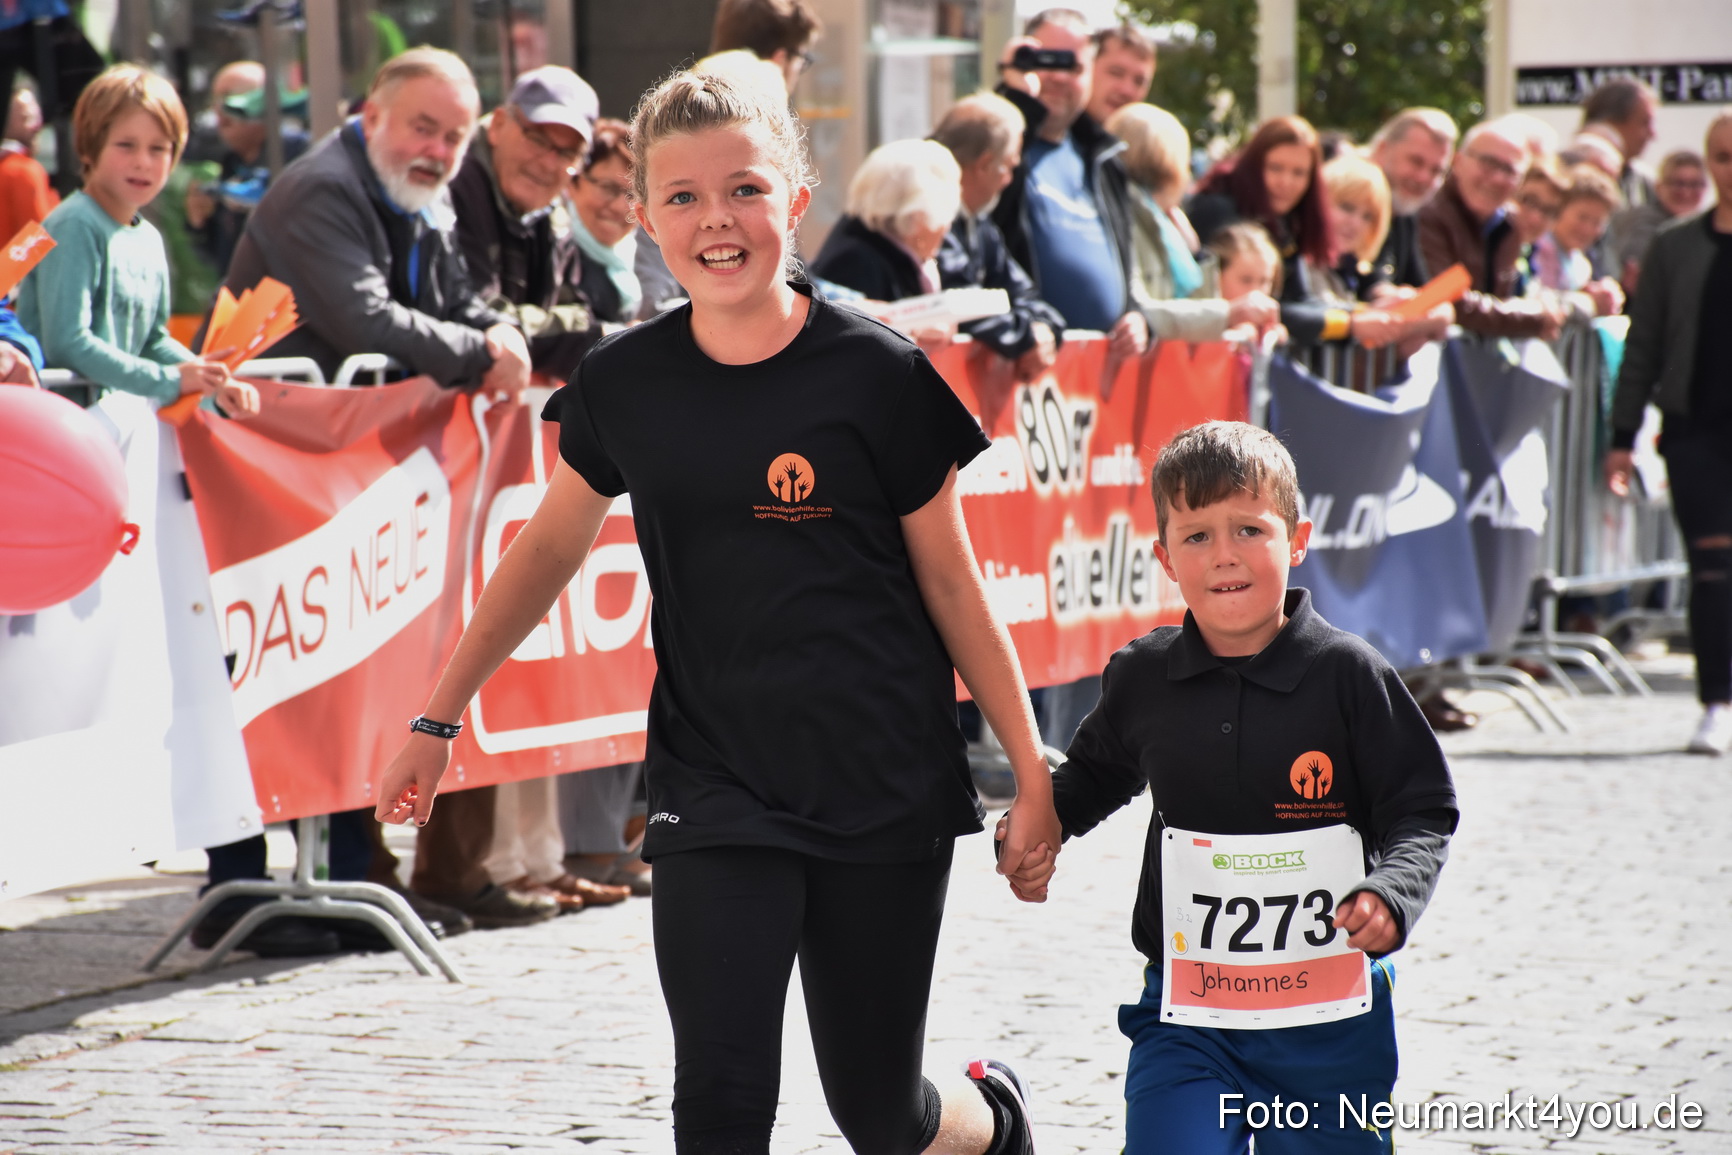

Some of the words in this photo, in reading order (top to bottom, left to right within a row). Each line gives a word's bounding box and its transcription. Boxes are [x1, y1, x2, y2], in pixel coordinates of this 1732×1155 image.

[753, 505, 832, 514] www.bolivienhilfe.com
[755, 513, 789, 521] HOFFNUNG
[790, 514, 802, 522] AUF
[225, 565, 330, 692] DAS
[349, 491, 429, 630] NEUE
[1275, 811, 1310, 820] HOFFNUNG
[1310, 811, 1323, 819] AUF
[1232, 850, 1306, 870] BOCK
[1282, 866, 1308, 874] concepts
[1192, 889, 1338, 953] 7273
[1190, 963, 1309, 998] Johannes
